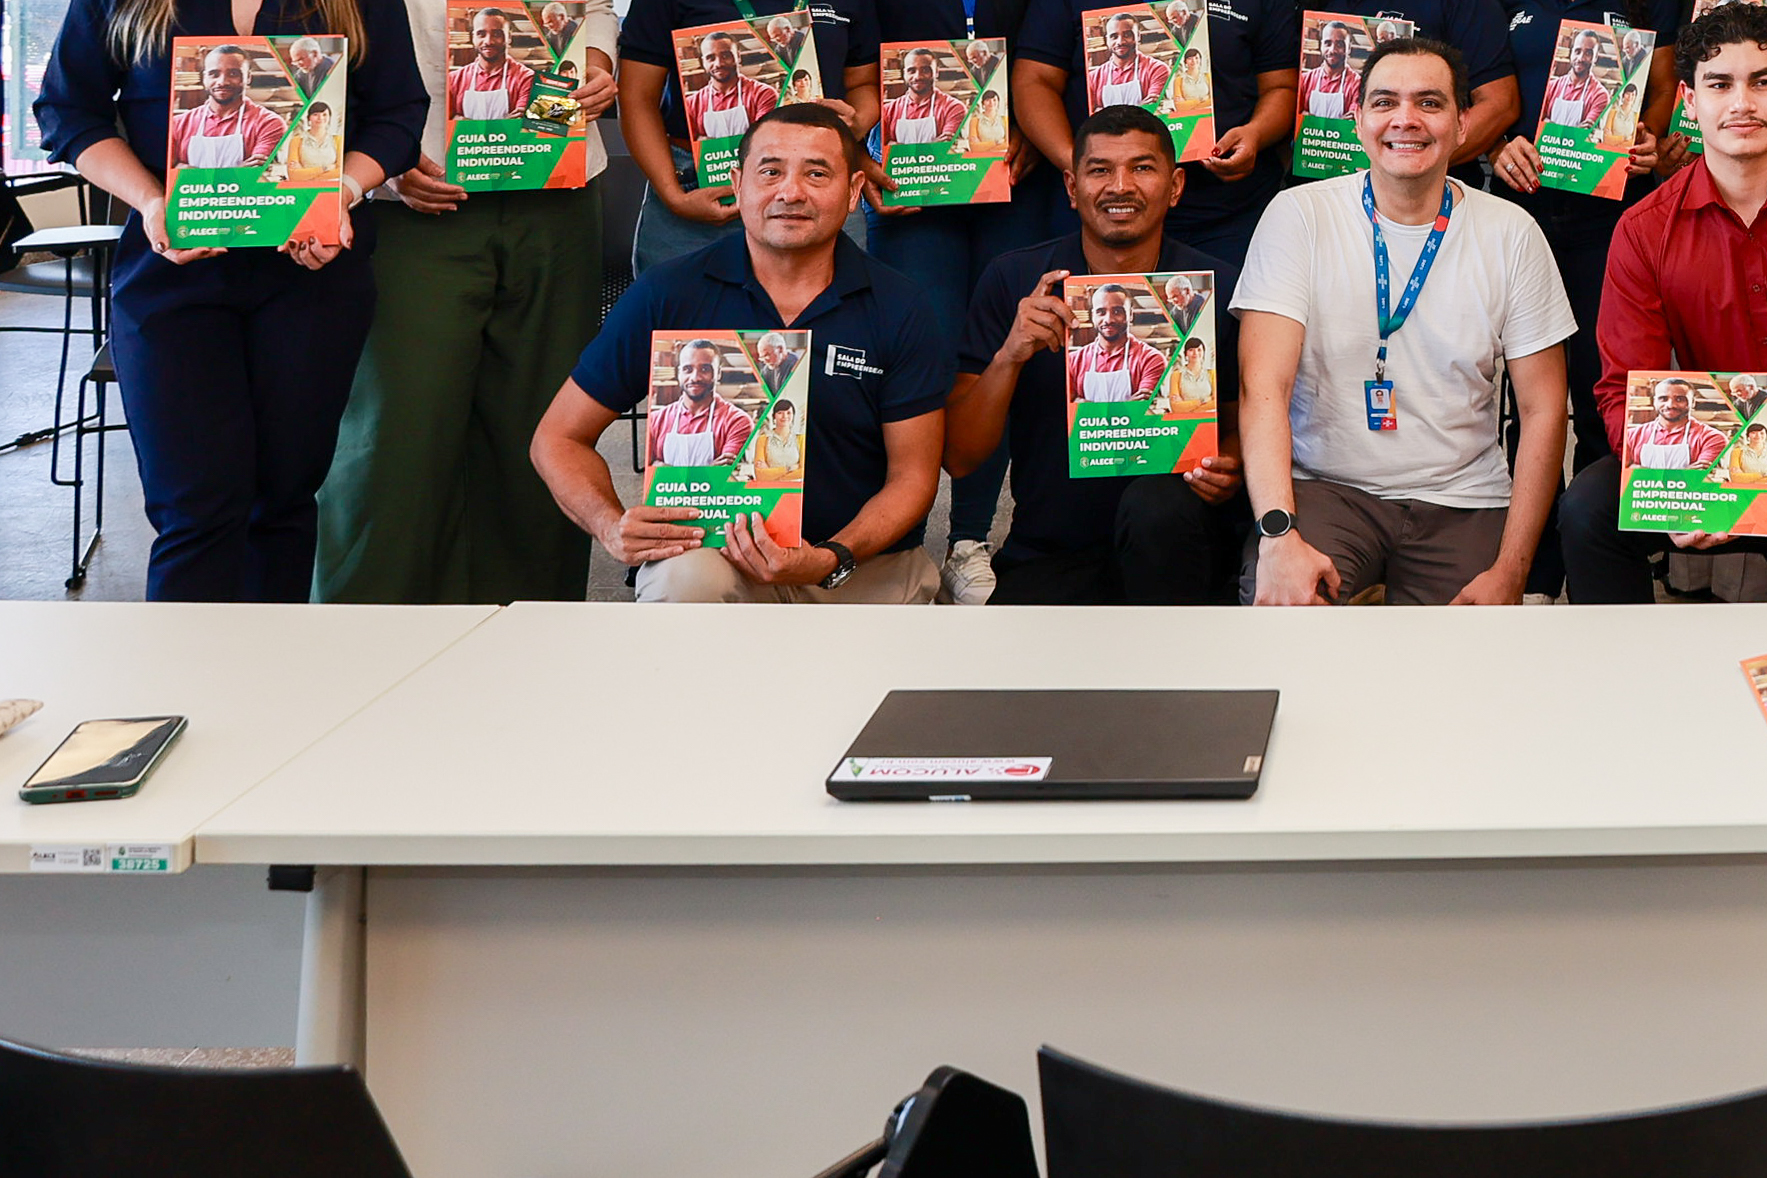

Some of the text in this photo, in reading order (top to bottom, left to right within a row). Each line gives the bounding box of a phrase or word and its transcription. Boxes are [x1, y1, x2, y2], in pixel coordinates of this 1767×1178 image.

[457, 133, 507, 143] GUIA DO
[1303, 128, 1340, 139] GUIA DO
[1302, 138, 1366, 153] EMPREENDED
[1542, 135, 1575, 147] GUIA DO
[1691, 136, 1703, 144] ECE
[457, 144, 552, 155] EMPREENDEDOR
[1301, 148, 1353, 161] INDIVIDUAL
[1540, 145, 1604, 164] EMPREENDEDOR
[704, 150, 733, 161] GUIA
[891, 155, 935, 165] GUIA DO
[457, 157, 524, 167] INDIVIDUAL
[1307, 162, 1326, 170] ALECE
[891, 163, 977, 176] EMPREENDEDOR
[1541, 170, 1558, 178] ALECE
[466, 173, 490, 181] ALECE
[892, 175, 952, 185] NDIVIDUAL
[179, 183, 239, 194] GUIA DO
[900, 190, 921, 198] ALECE
[178, 195, 296, 208] EMPREENDEDOR
[178, 209, 261, 221] INDIVIDUAL
[189, 227, 218, 236] ALECE
[837, 353, 866, 365] SALA DO
[1079, 416, 1130, 427] GUIA DO
[1079, 426, 1179, 439] EMPREENDEDOR
[1080, 440, 1150, 452] INDIVIDUAL
[1090, 458, 1114, 466] ALECE
[655, 482, 710, 493] GUIA DO
[1632, 480, 1687, 489] GUIA DO
[655, 495, 762, 506] EMPREENDEDOR
[1632, 490, 1738, 502] EMPREENDEDOR
[1632, 500, 1706, 511] INDIVIDUAL
[870, 768, 980, 776] ALUCOM
